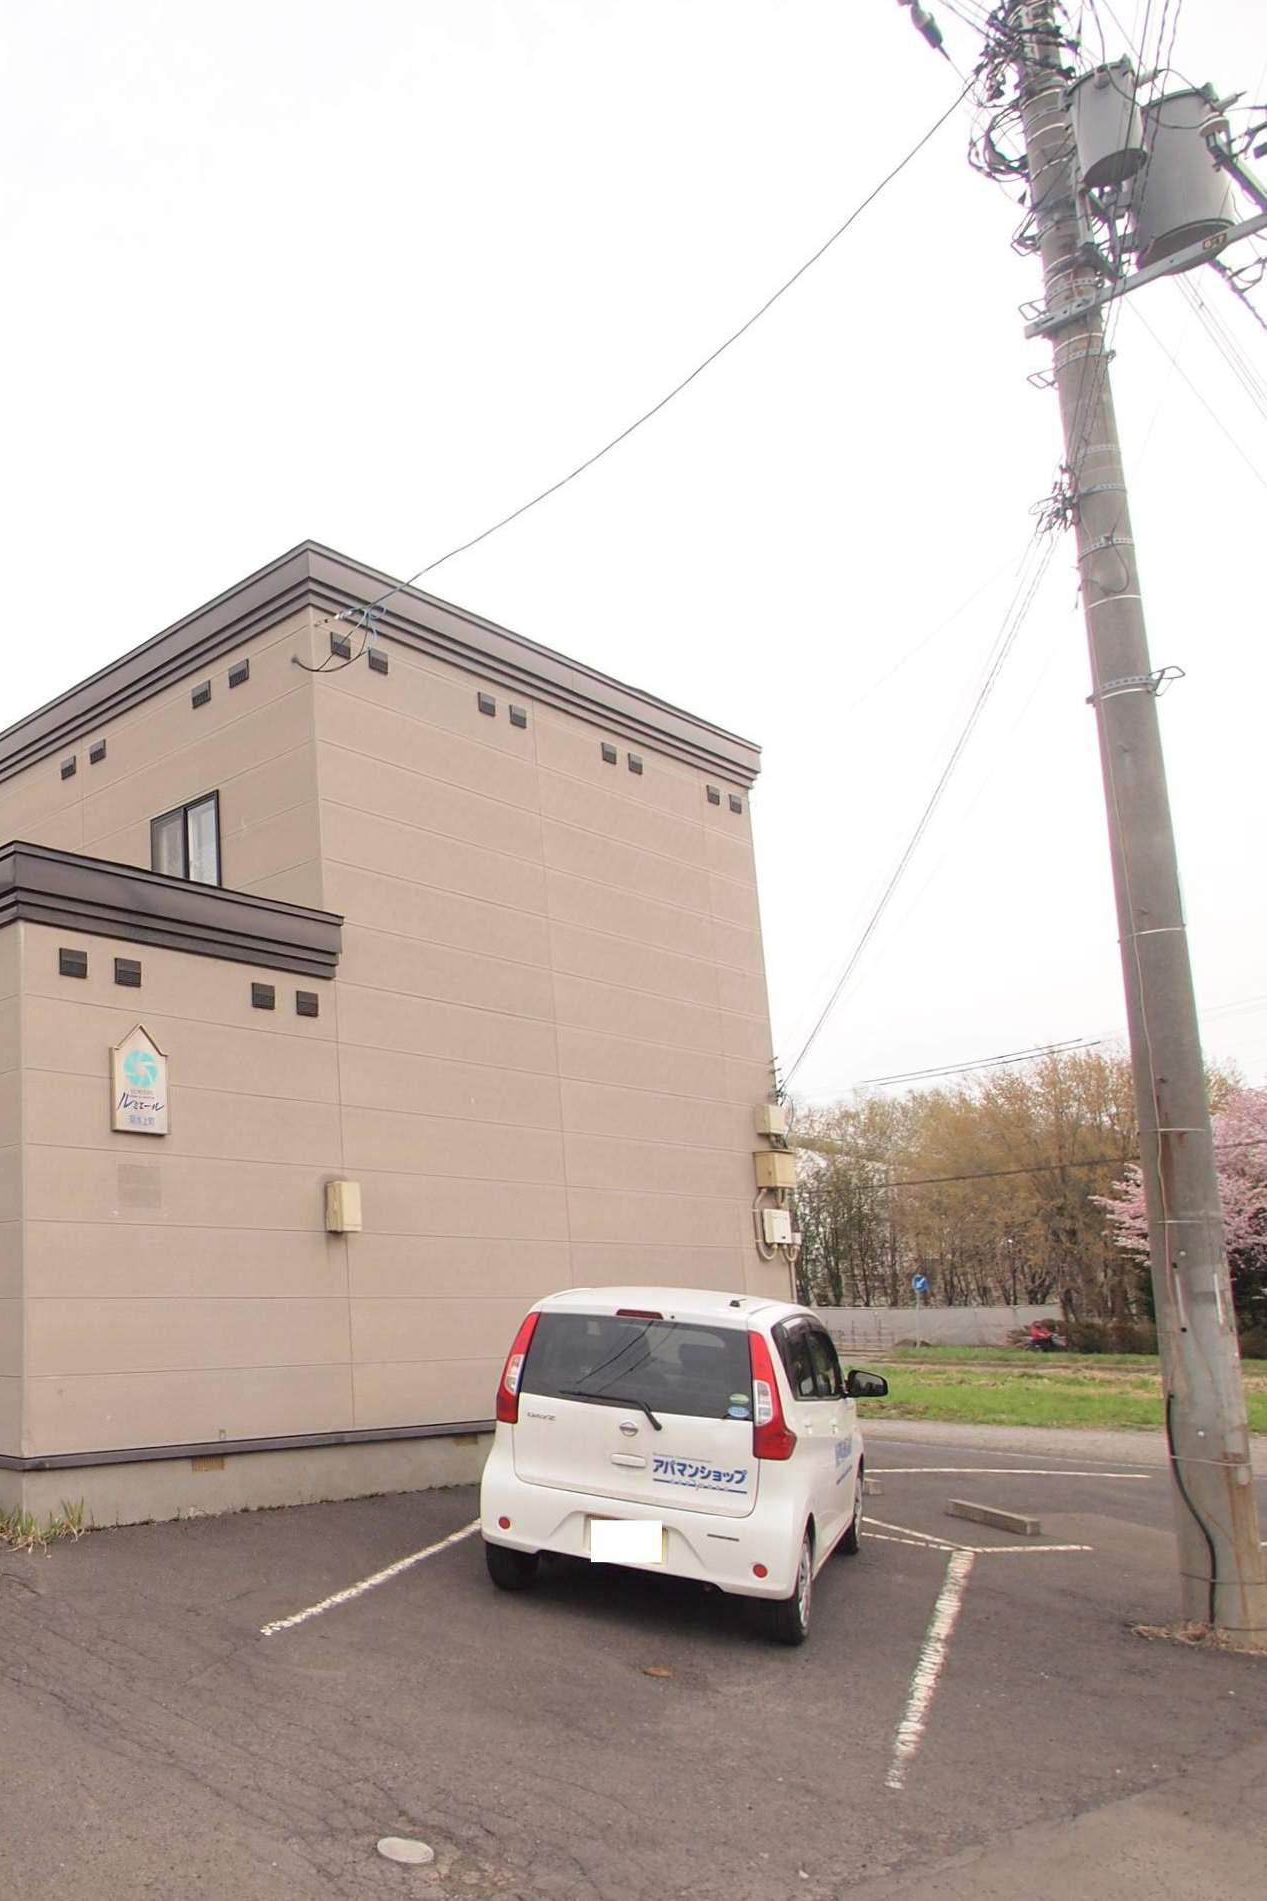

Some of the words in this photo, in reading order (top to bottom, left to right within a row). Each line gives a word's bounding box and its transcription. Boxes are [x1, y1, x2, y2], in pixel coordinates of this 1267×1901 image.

[116, 1091, 165, 1112] ルミエール
[653, 1458, 748, 1485] アパマンショップ
